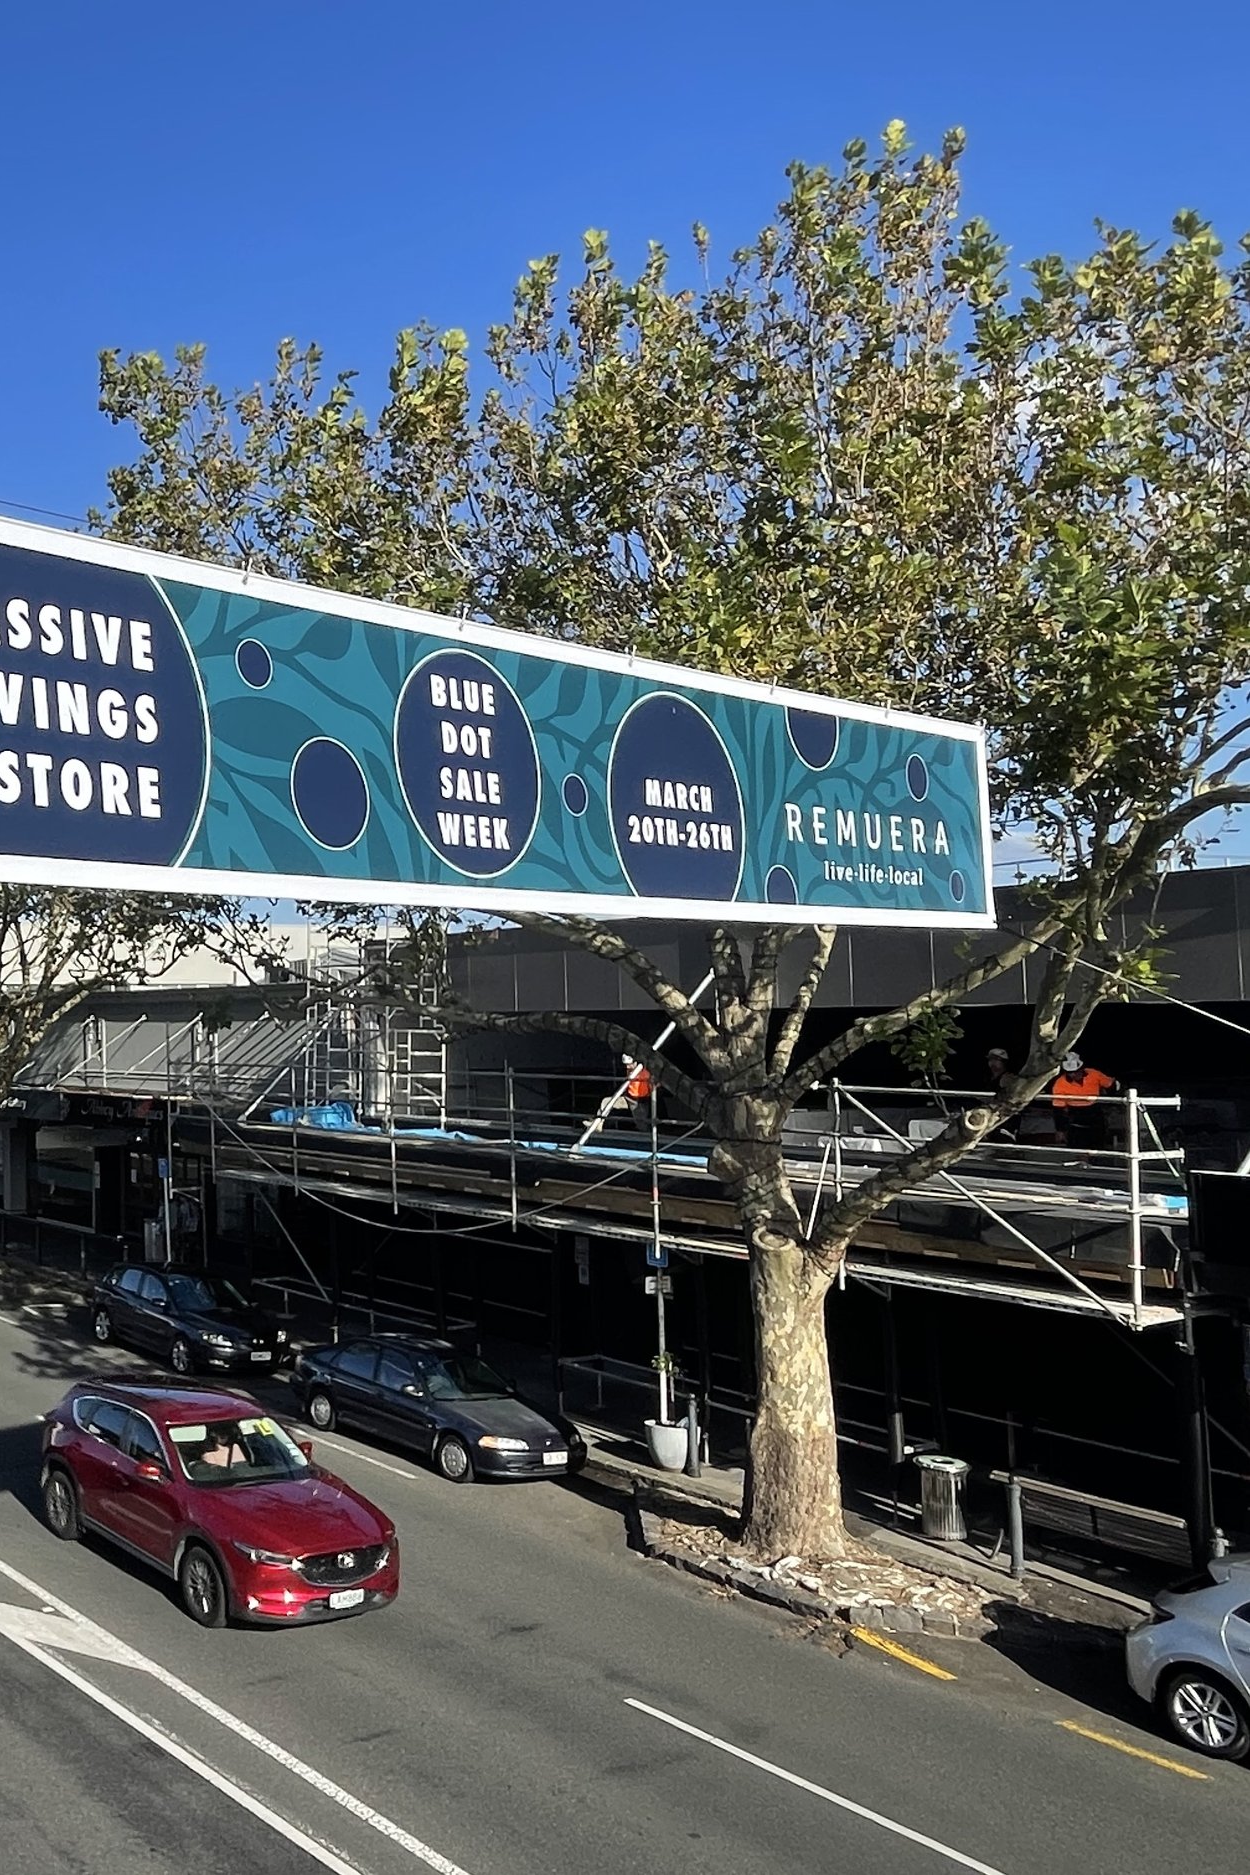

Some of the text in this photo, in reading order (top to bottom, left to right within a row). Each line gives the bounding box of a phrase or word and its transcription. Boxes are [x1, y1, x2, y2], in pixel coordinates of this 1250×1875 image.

[430, 673, 495, 716] BLUE
[441, 720, 492, 759] DOT
[440, 766, 501, 805] SALE
[645, 777, 713, 813] MARCH
[436, 812, 511, 851] WEEK
[628, 815, 733, 851] 20TH-26TH
[784, 802, 950, 856] REMUERA
